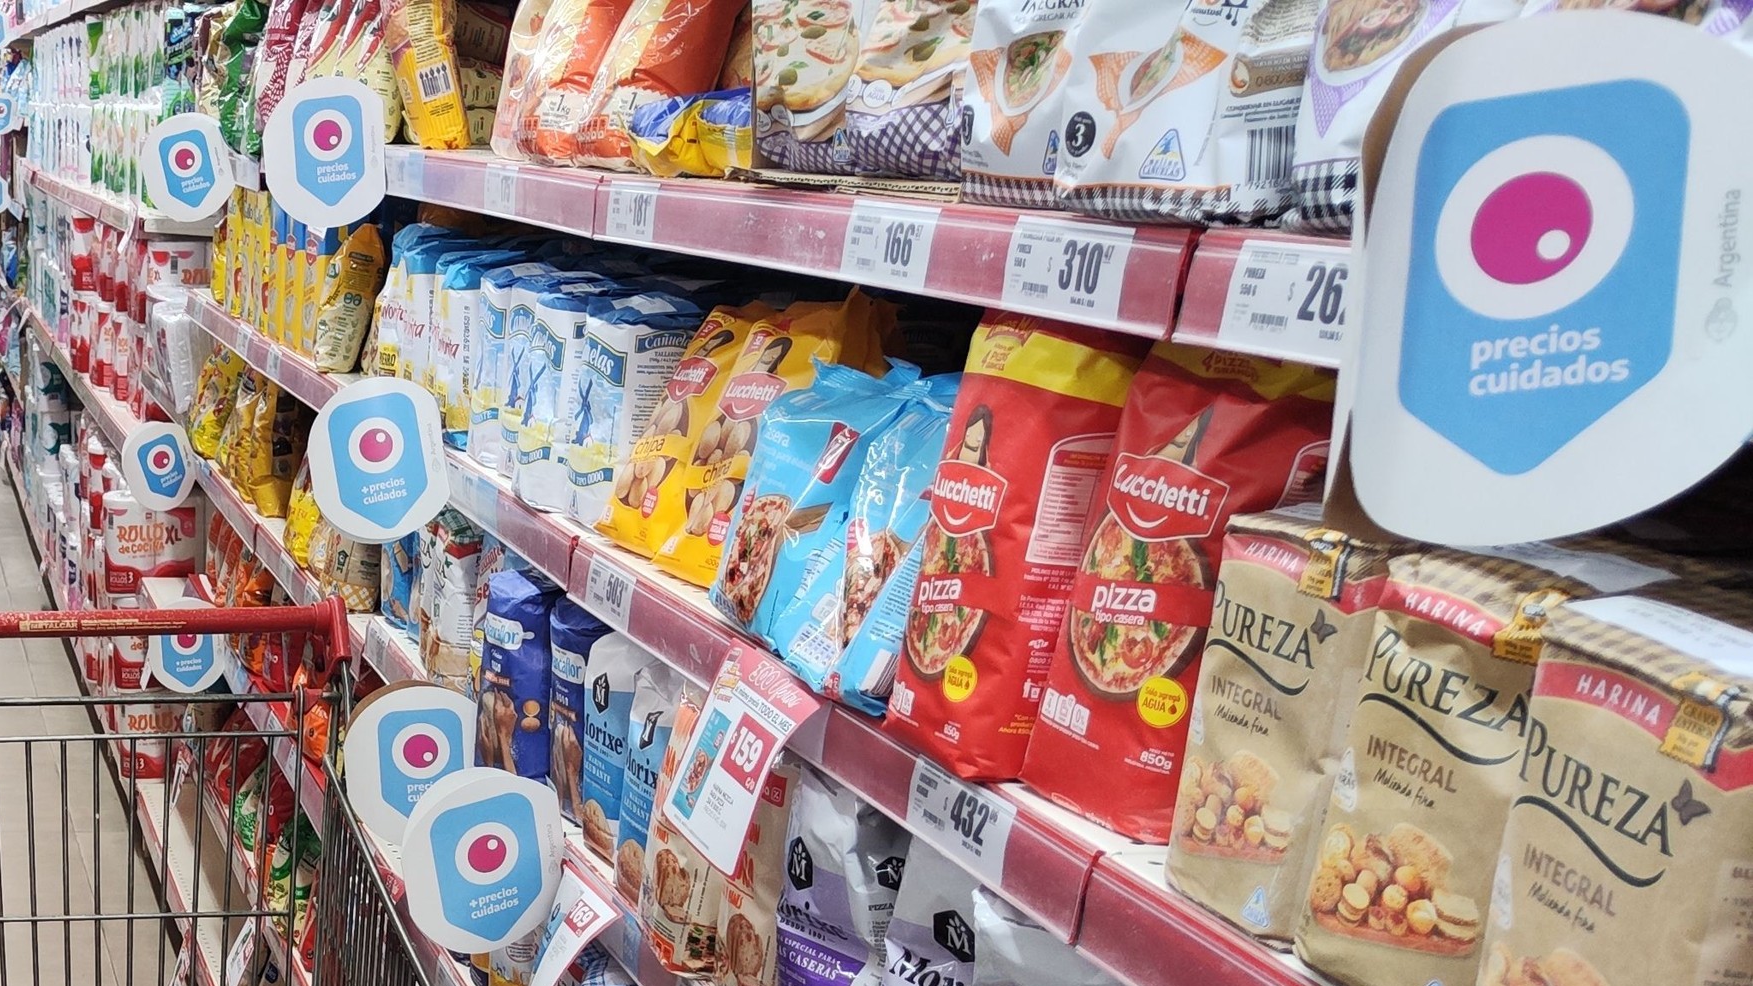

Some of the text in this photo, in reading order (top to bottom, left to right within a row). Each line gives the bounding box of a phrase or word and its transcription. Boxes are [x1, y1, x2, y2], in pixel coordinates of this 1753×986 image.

[1075, 123, 1086, 147] 3
[316, 163, 349, 176] precios
[317, 172, 357, 184] cuidados
[883, 221, 916, 266] 166
[1723, 188, 1742, 287] Argentina
[1058, 239, 1104, 295] 310
[1297, 261, 1349, 325] 26
[1470, 325, 1601, 370] precios
[725, 381, 781, 400] Lucchetti
[1468, 353, 1630, 396] cuidados
[363, 488, 407, 505] cuidados
[934, 472, 997, 513] Lucchetti
[1112, 463, 1210, 515] Lucchetti
[117, 523, 181, 545] ROLLO XL
[1244, 542, 1300, 572] HARINA
[606, 574, 623, 607] 503
[918, 577, 962, 605] pizza
[1091, 583, 1157, 613] pizza
[1095, 611, 1145, 627] tipo casera
[1214, 579, 1315, 670] PUREZA
[1405, 593, 1487, 636] HARINA
[1212, 675, 1282, 721] INTEGRAL
[1364, 625, 1530, 738] PUREZA
[1577, 674, 1663, 725] HARINA
[1142, 699, 1166, 713] AGUA
[731, 726, 762, 772] 159
[1140, 751, 1173, 769] 850g
[1367, 735, 1457, 793] INTEGRAL
[1518, 716, 1674, 858] PUREZA
[950, 790, 990, 847] 432
[1523, 844, 1616, 917] INTEGRAL
[471, 898, 519, 920] cuidados
[789, 950, 838, 982] CASERAS
